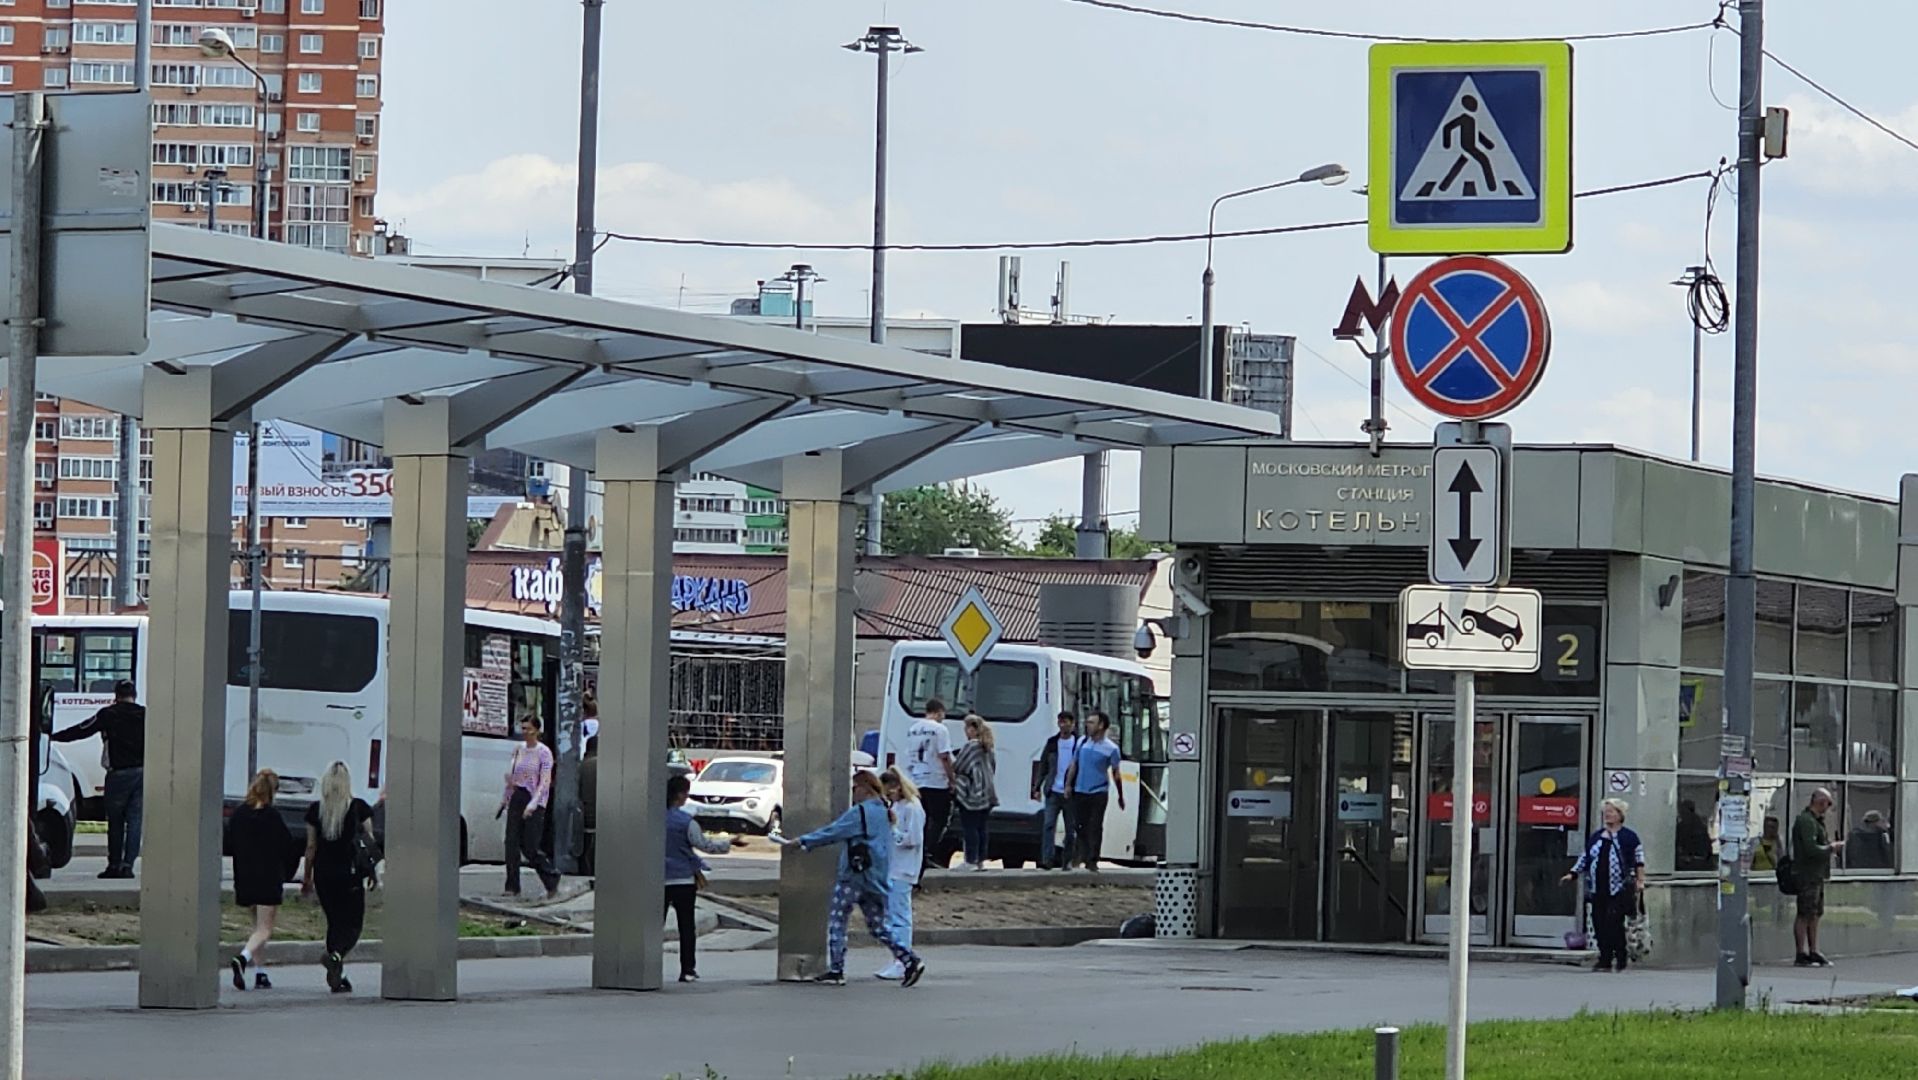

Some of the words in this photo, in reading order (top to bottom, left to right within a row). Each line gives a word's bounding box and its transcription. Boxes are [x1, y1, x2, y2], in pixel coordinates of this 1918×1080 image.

[234, 483, 285, 497] ПЕВЫЙ
[287, 486, 329, 497] ВЗНОС
[331, 486, 348, 497] ОТ
[1337, 487, 1415, 503] СТАНЦИЯ
[1256, 509, 1431, 532] КОТЕЛЬН
[513, 557, 564, 614] каф
[1557, 633, 1579, 666] 2
